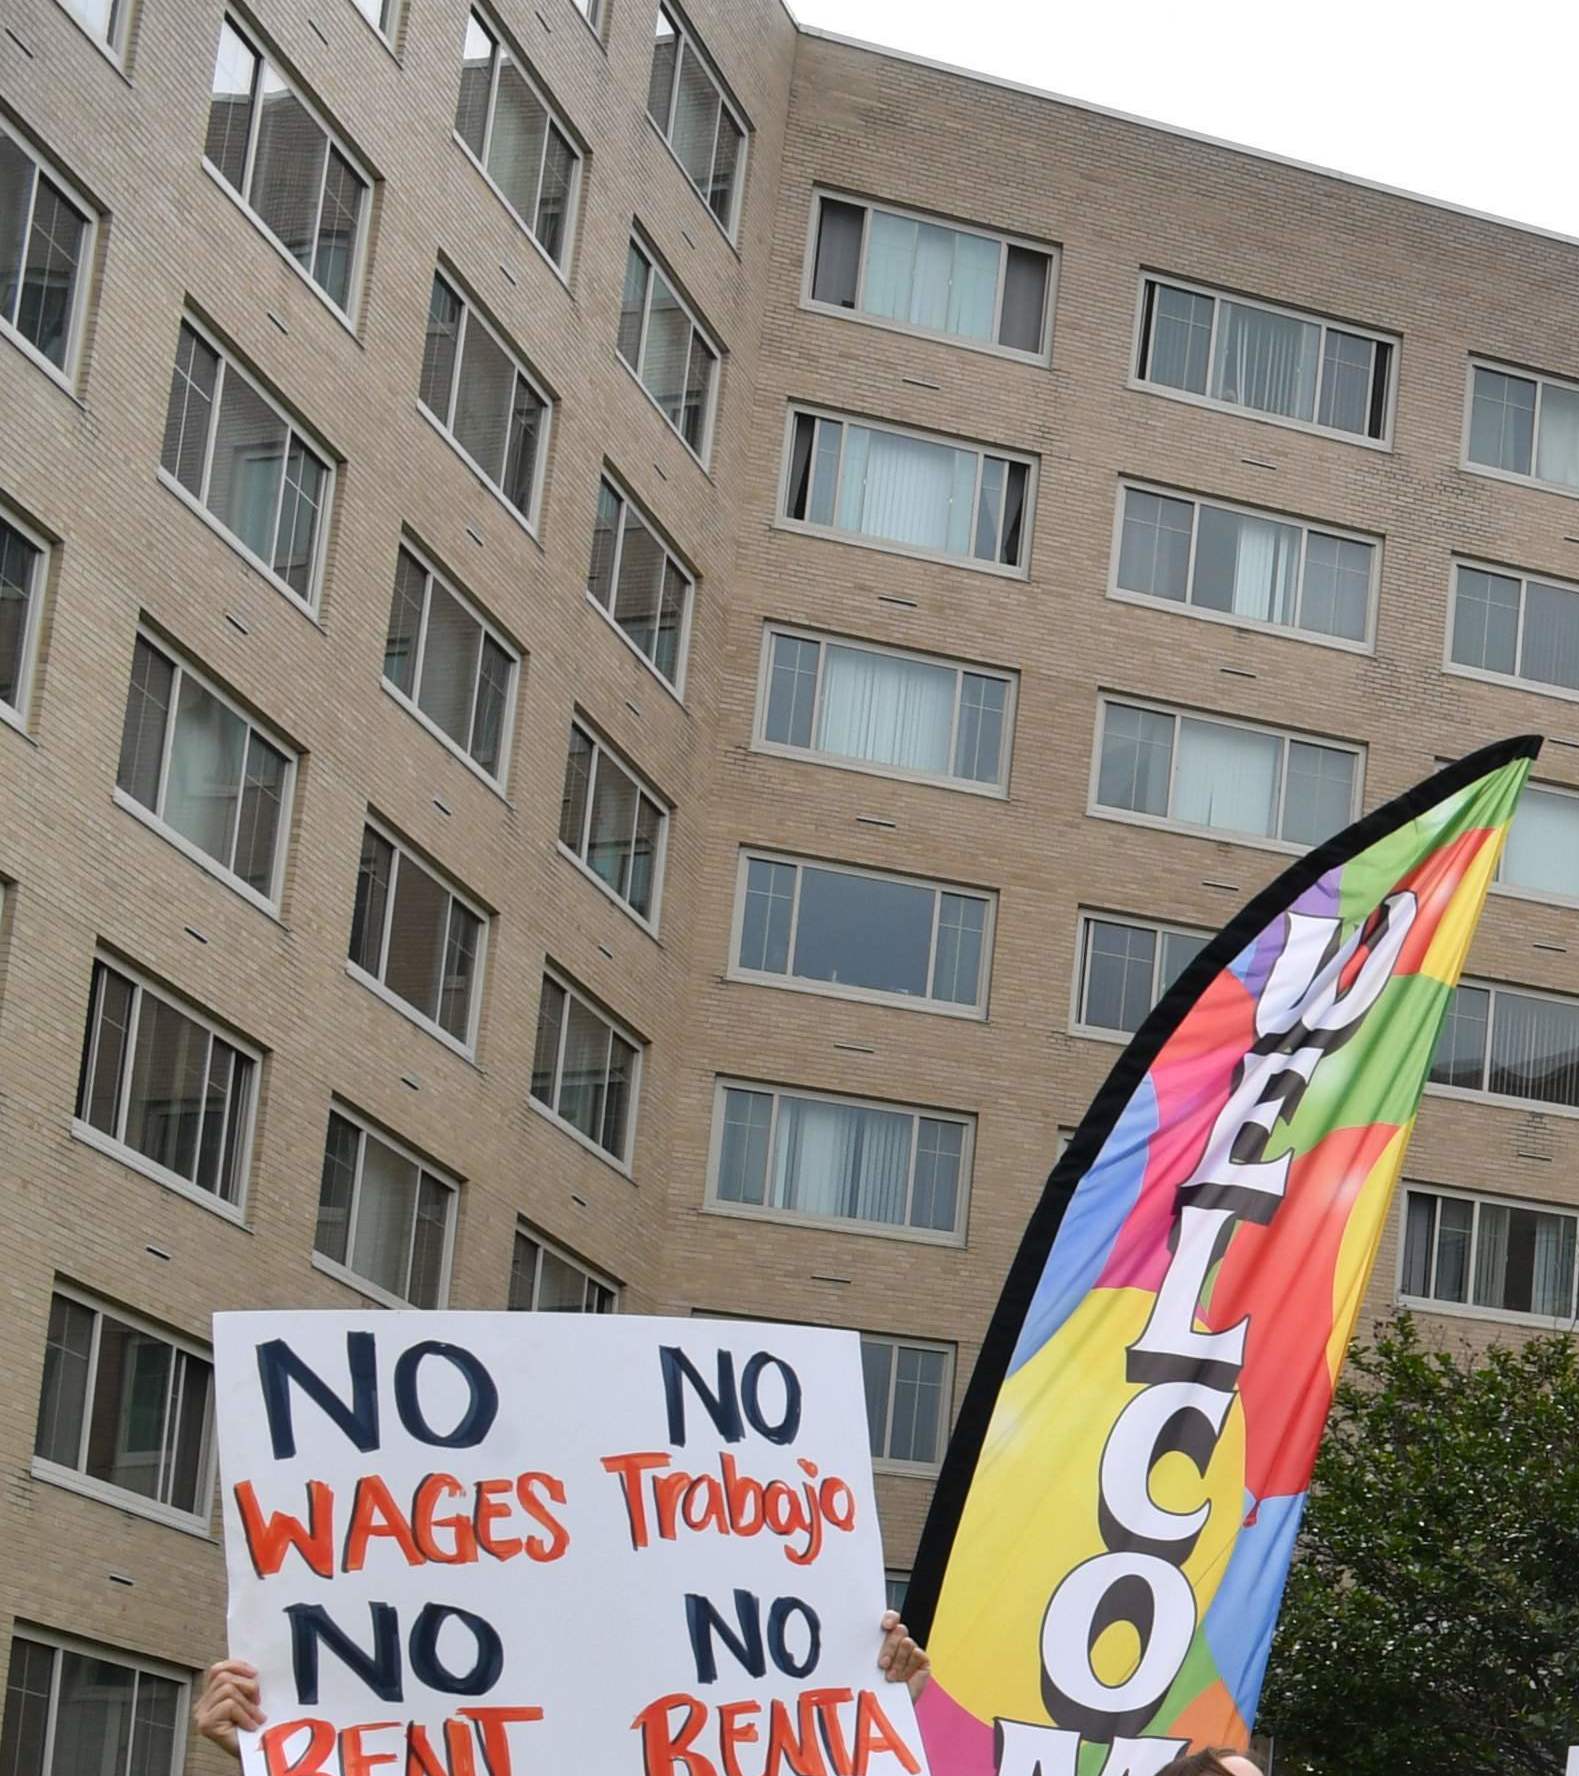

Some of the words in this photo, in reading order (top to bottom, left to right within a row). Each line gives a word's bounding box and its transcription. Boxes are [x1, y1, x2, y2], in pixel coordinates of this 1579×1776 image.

[255, 1331, 500, 1460] NO
[658, 1344, 803, 1447] NO
[234, 1471, 570, 1580] WAGES
[600, 1451, 856, 1566] Trabajo
[283, 1601, 505, 1706] NO
[685, 1588, 822, 1685] NO
